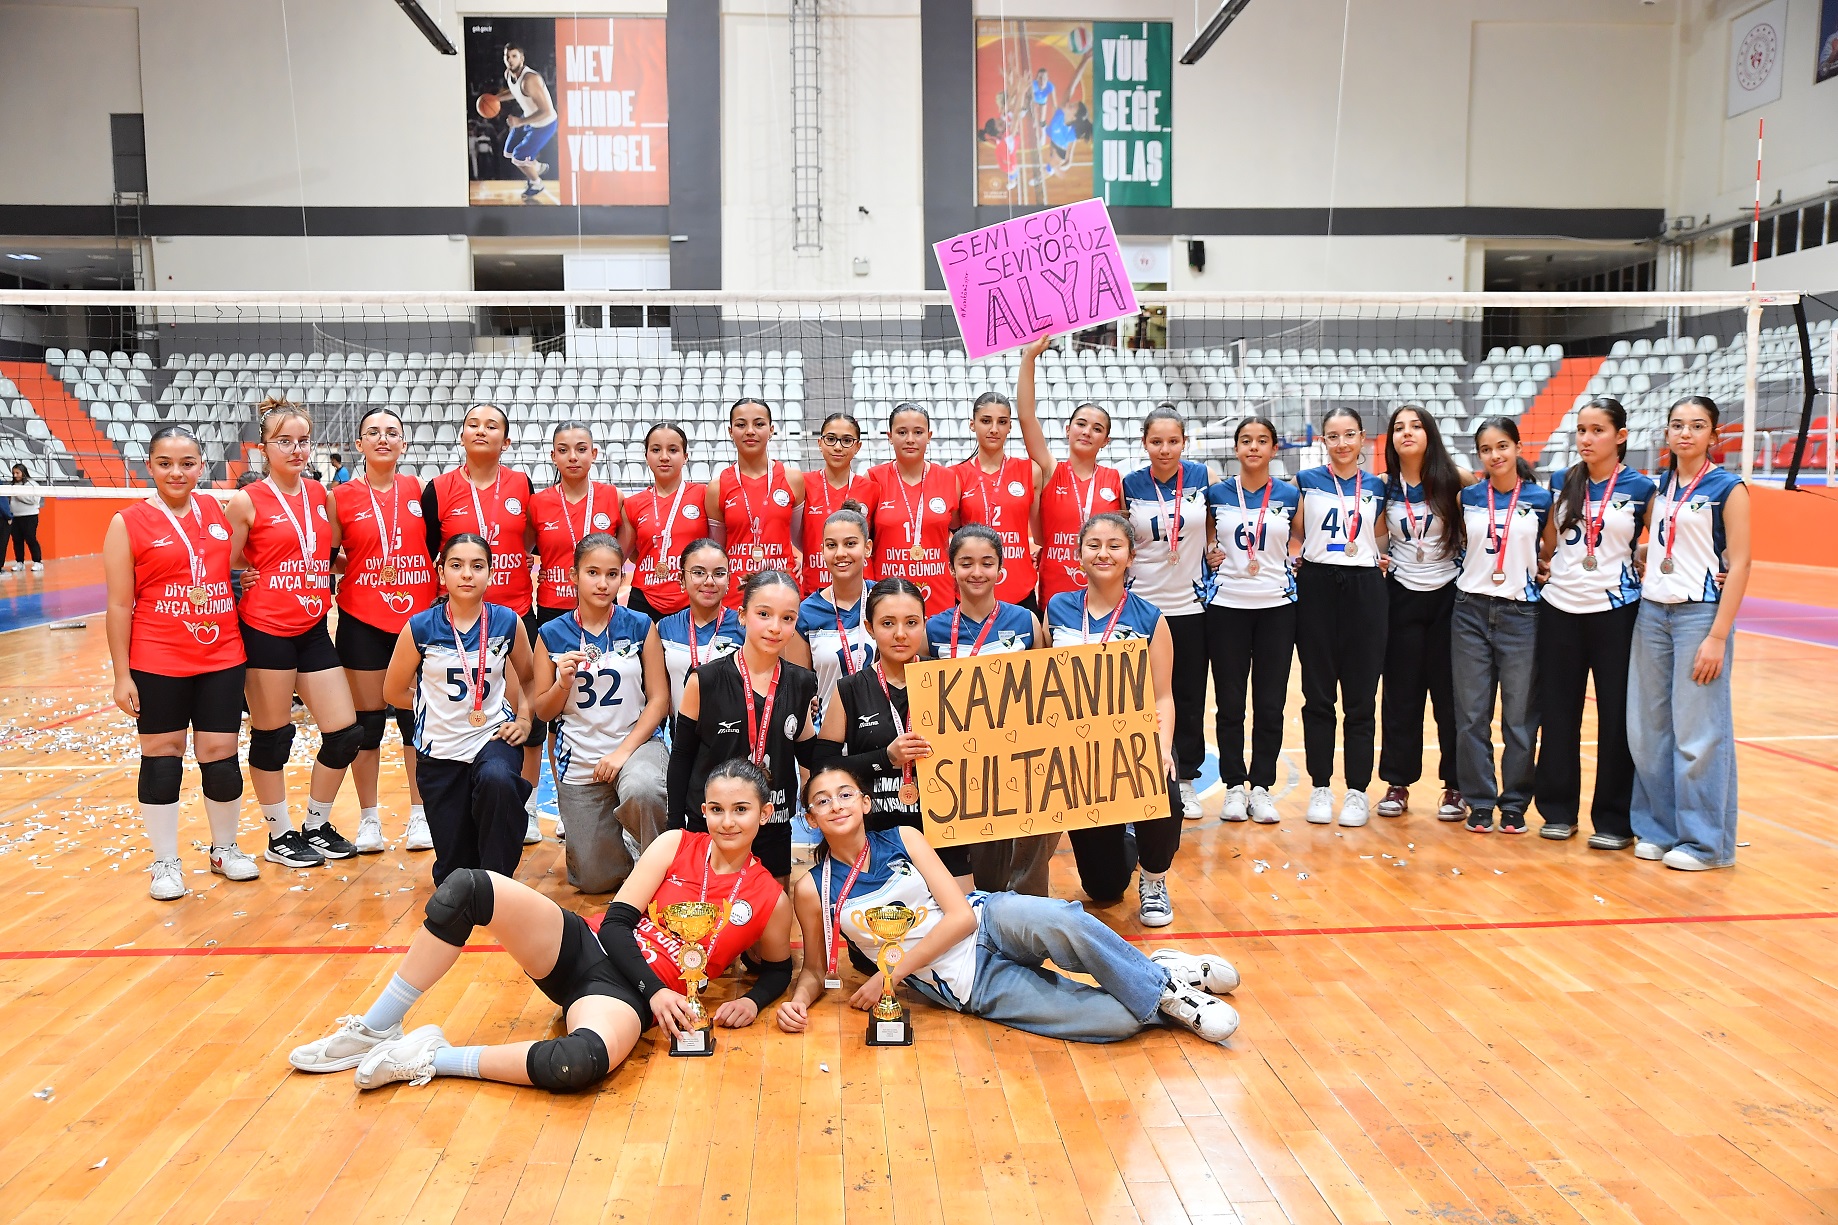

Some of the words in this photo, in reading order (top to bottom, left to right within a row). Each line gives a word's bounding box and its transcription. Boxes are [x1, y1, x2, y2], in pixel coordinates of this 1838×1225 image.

[566, 45, 614, 82] MEV
[1101, 35, 1148, 81] YÜK
[567, 87, 636, 127] KİNDE
[1102, 85, 1162, 131] SEĞE
[567, 131, 656, 171] YÜKSEL
[1102, 140, 1163, 186] ULAŞ
[949, 223, 1009, 265] SENİ
[1025, 208, 1077, 241] ÇOK
[978, 226, 1110, 286] SEVİYORUZ
[987, 252, 1127, 347] ALYA
[491, 553, 522, 569] ROSS
[909, 561, 946, 576] GÜNDAY
[1003, 547, 1025, 559] NDAY
[270, 575, 302, 592] AYÇA
[490, 571, 511, 586] KET
[155, 600, 190, 617] AYÇA
[575, 669, 623, 709] 32
[938, 644, 1148, 734] KAMANİN
[927, 731, 1166, 824] SULTANLARI
